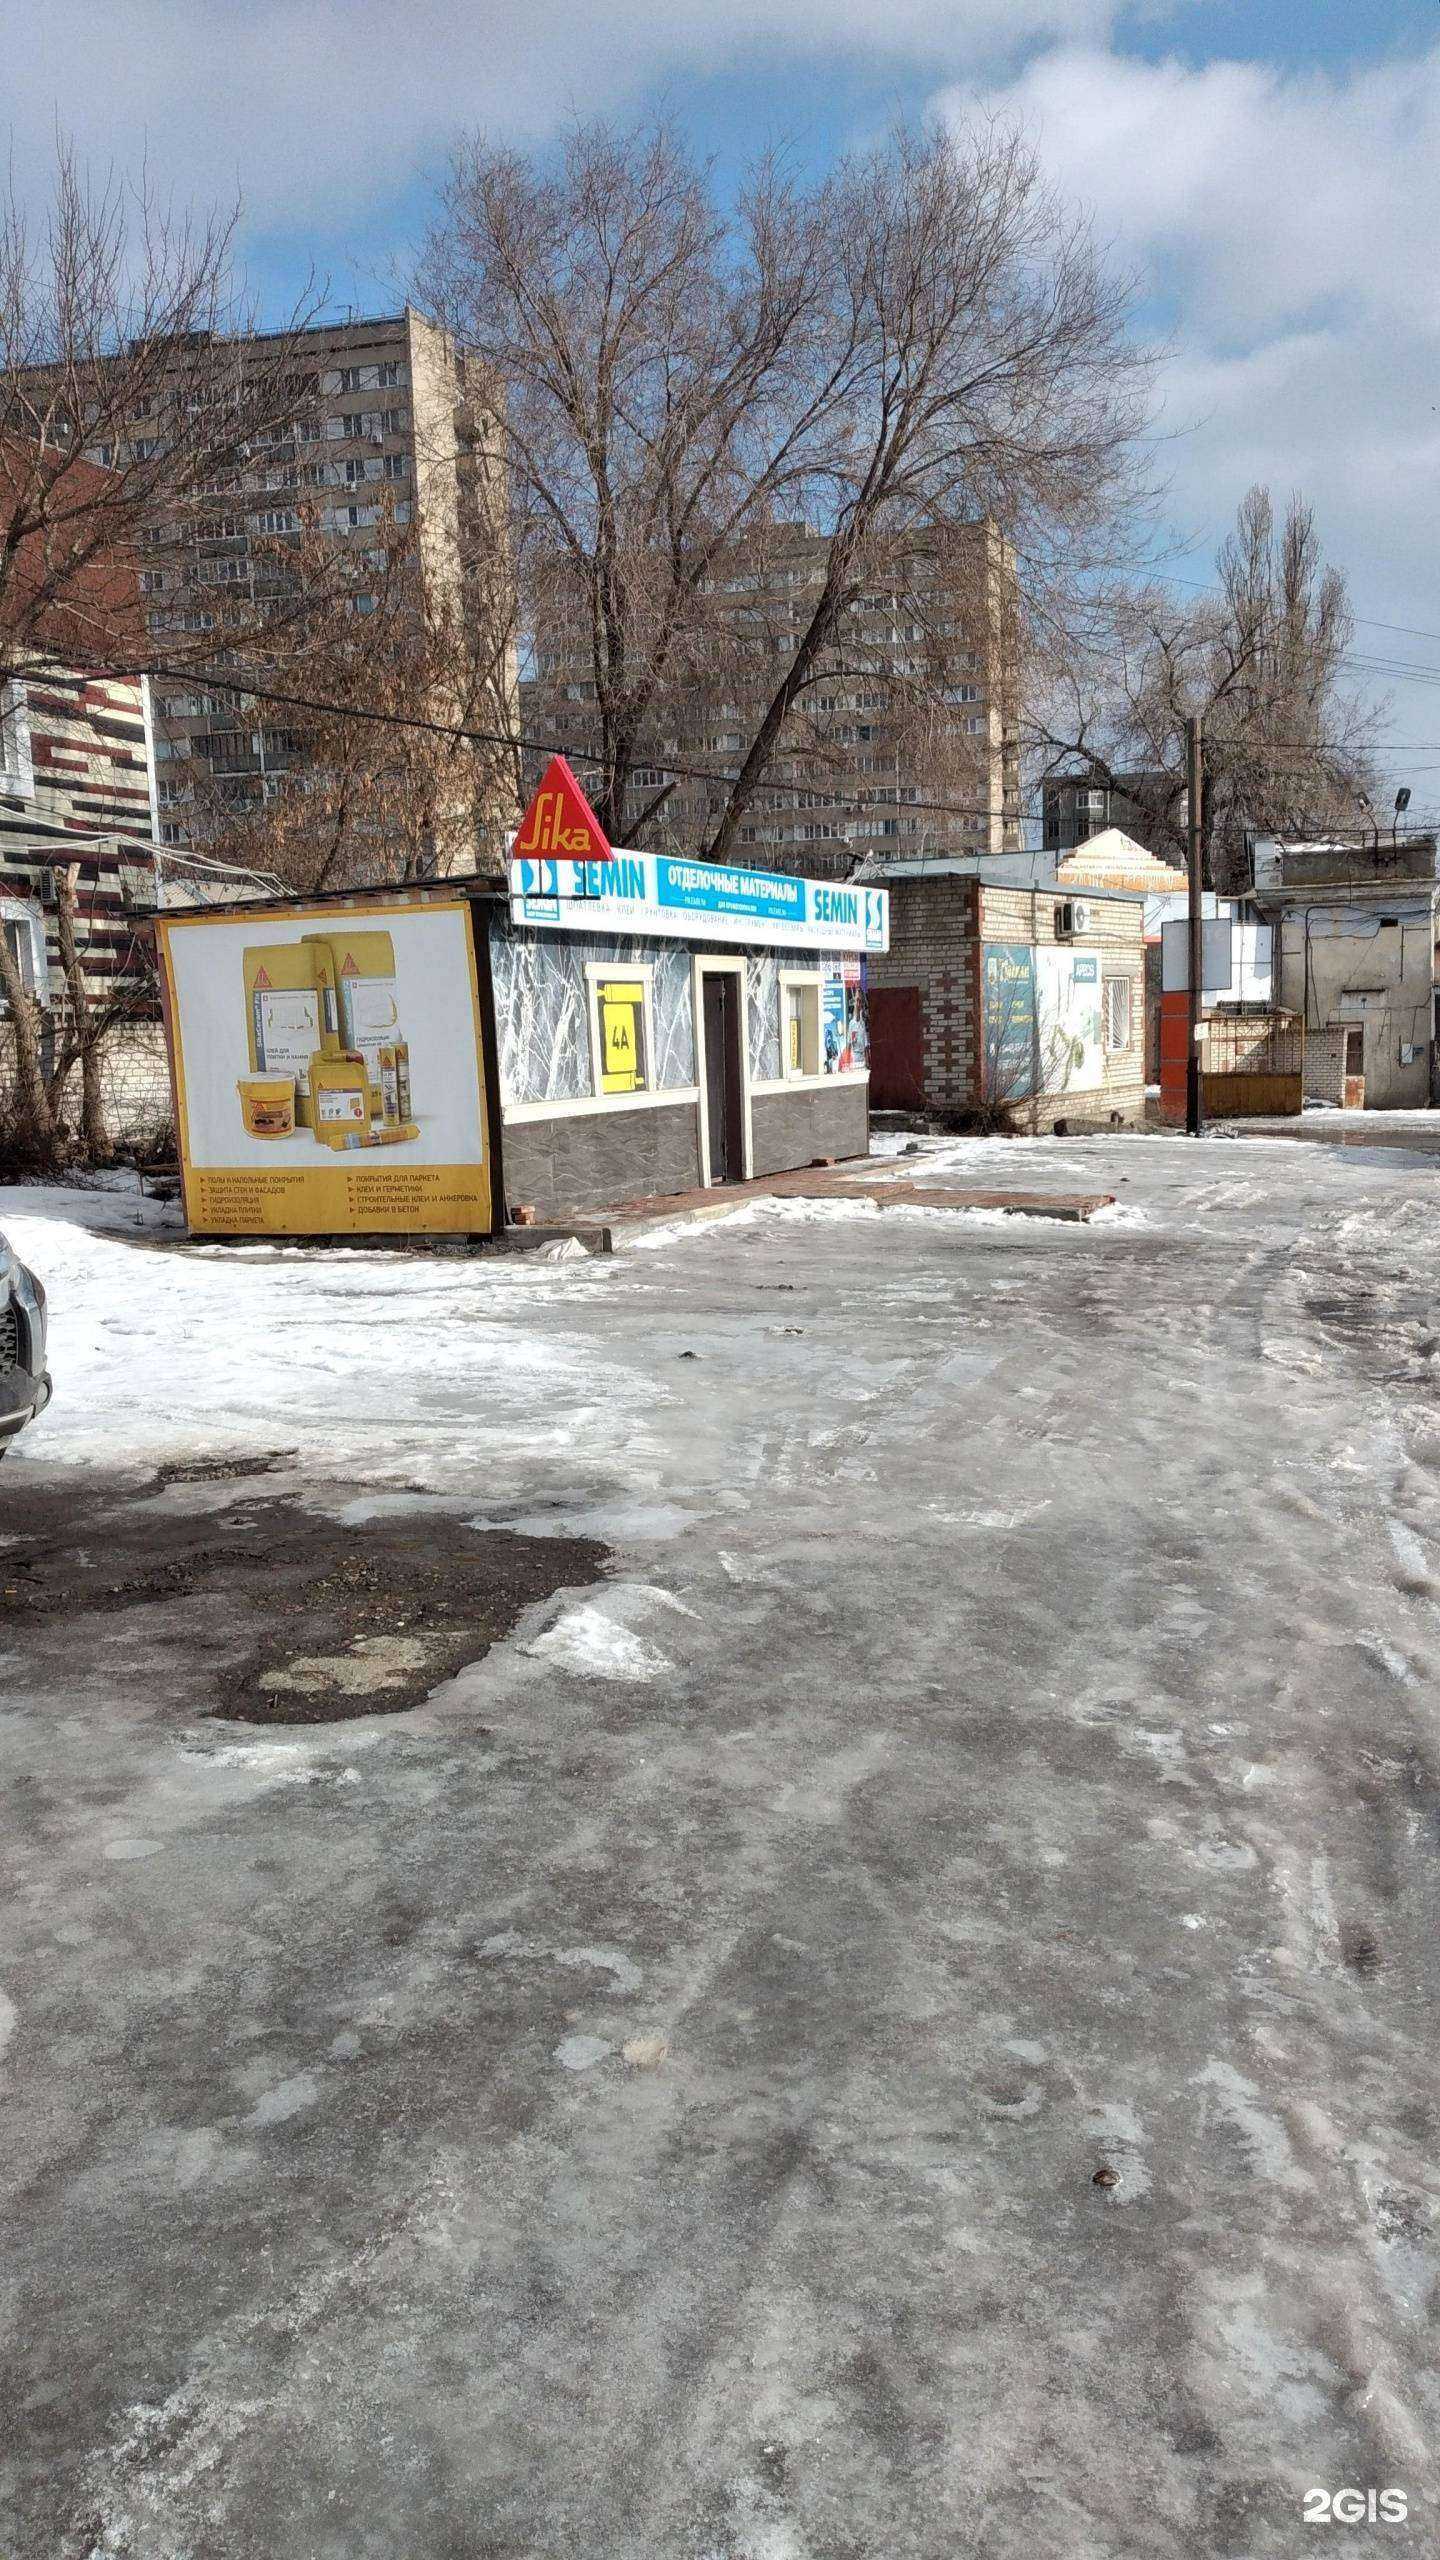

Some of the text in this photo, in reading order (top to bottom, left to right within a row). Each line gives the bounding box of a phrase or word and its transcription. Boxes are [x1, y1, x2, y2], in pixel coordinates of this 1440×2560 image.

[520, 792, 591, 850] Sika
[573, 859, 645, 899] SEMIN
[668, 865, 798, 903] ОТДЕЛОЧНЫЕ МАТЕРИАЛЫ
[814, 889, 858, 924] SEMIN
[356, 1174, 440, 1183] ПОКРЫТИЯ ДЛЯ ПАРКЕТА
[255, 1186, 286, 1195] ФАСАДОВ
[357, 1195, 410, 1203] СТРОИТЕЛЬНЫЕ
[439, 1194, 478, 1202] АНКЕРОВКА
[358, 1205, 420, 1214] ДОБАВКИ В БЕТОН
